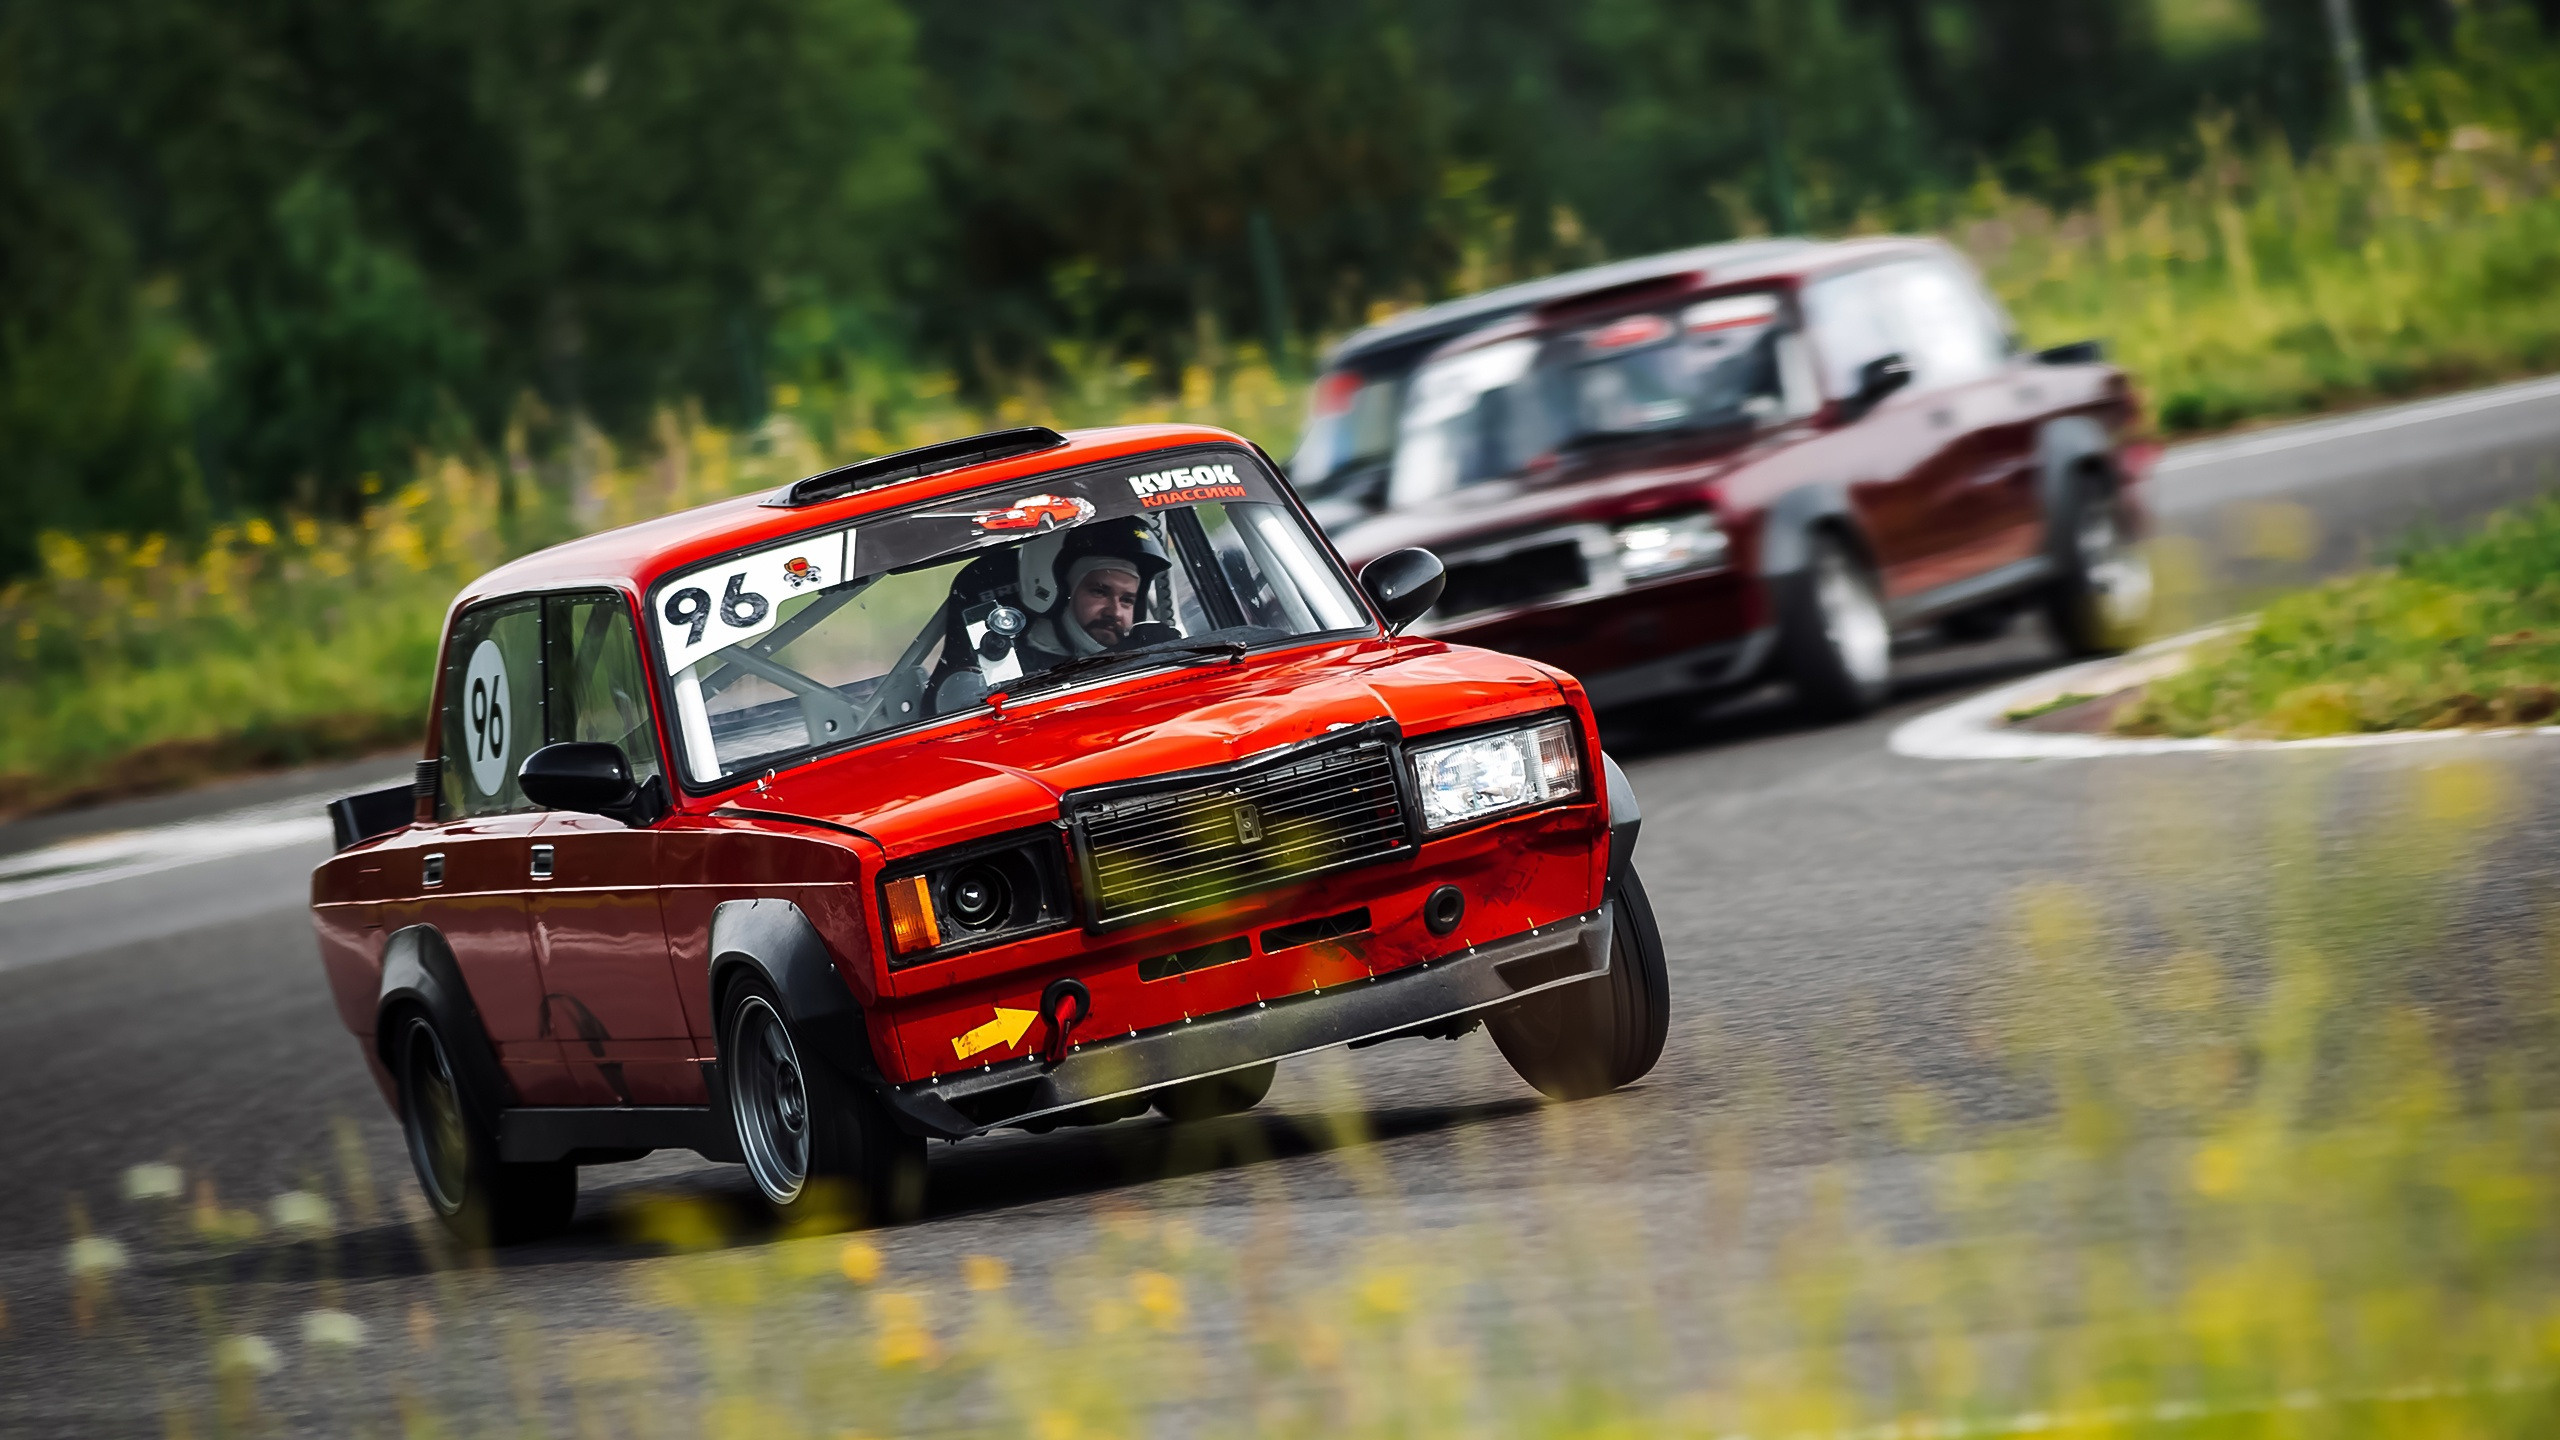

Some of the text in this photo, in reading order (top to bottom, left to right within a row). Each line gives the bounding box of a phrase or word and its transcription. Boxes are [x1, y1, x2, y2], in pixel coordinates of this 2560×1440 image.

[1129, 464, 1240, 498] КУБОК
[1140, 486, 1247, 508] КЛАССИКИ
[665, 572, 769, 648] 96
[472, 675, 503, 762] 96
